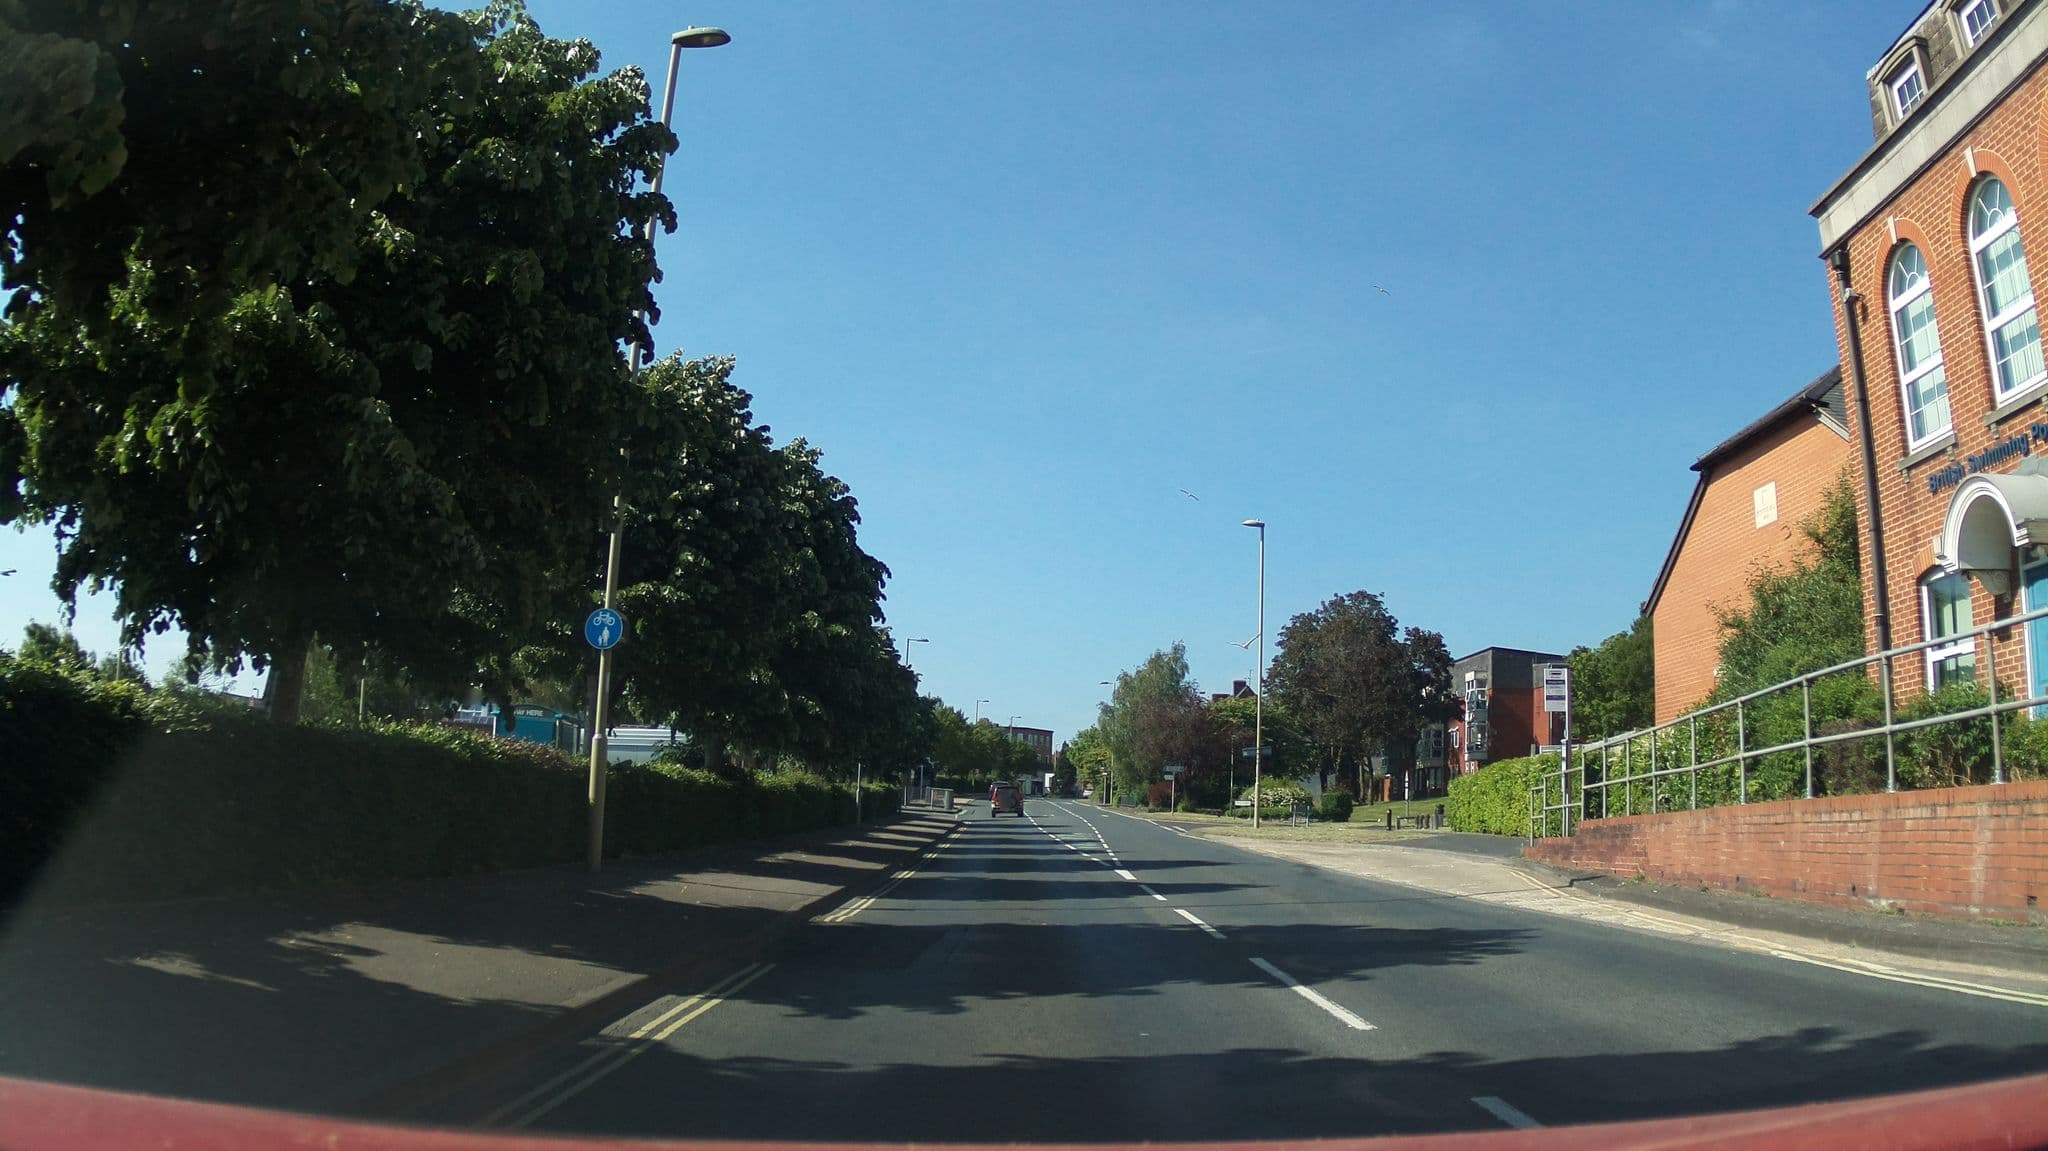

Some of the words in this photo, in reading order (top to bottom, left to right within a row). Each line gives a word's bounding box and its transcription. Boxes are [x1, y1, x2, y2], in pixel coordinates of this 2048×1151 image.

[1929, 463, 1965, 493] British
[1968, 434, 2029, 472] Swimming
[526, 709, 544, 717] HERE
